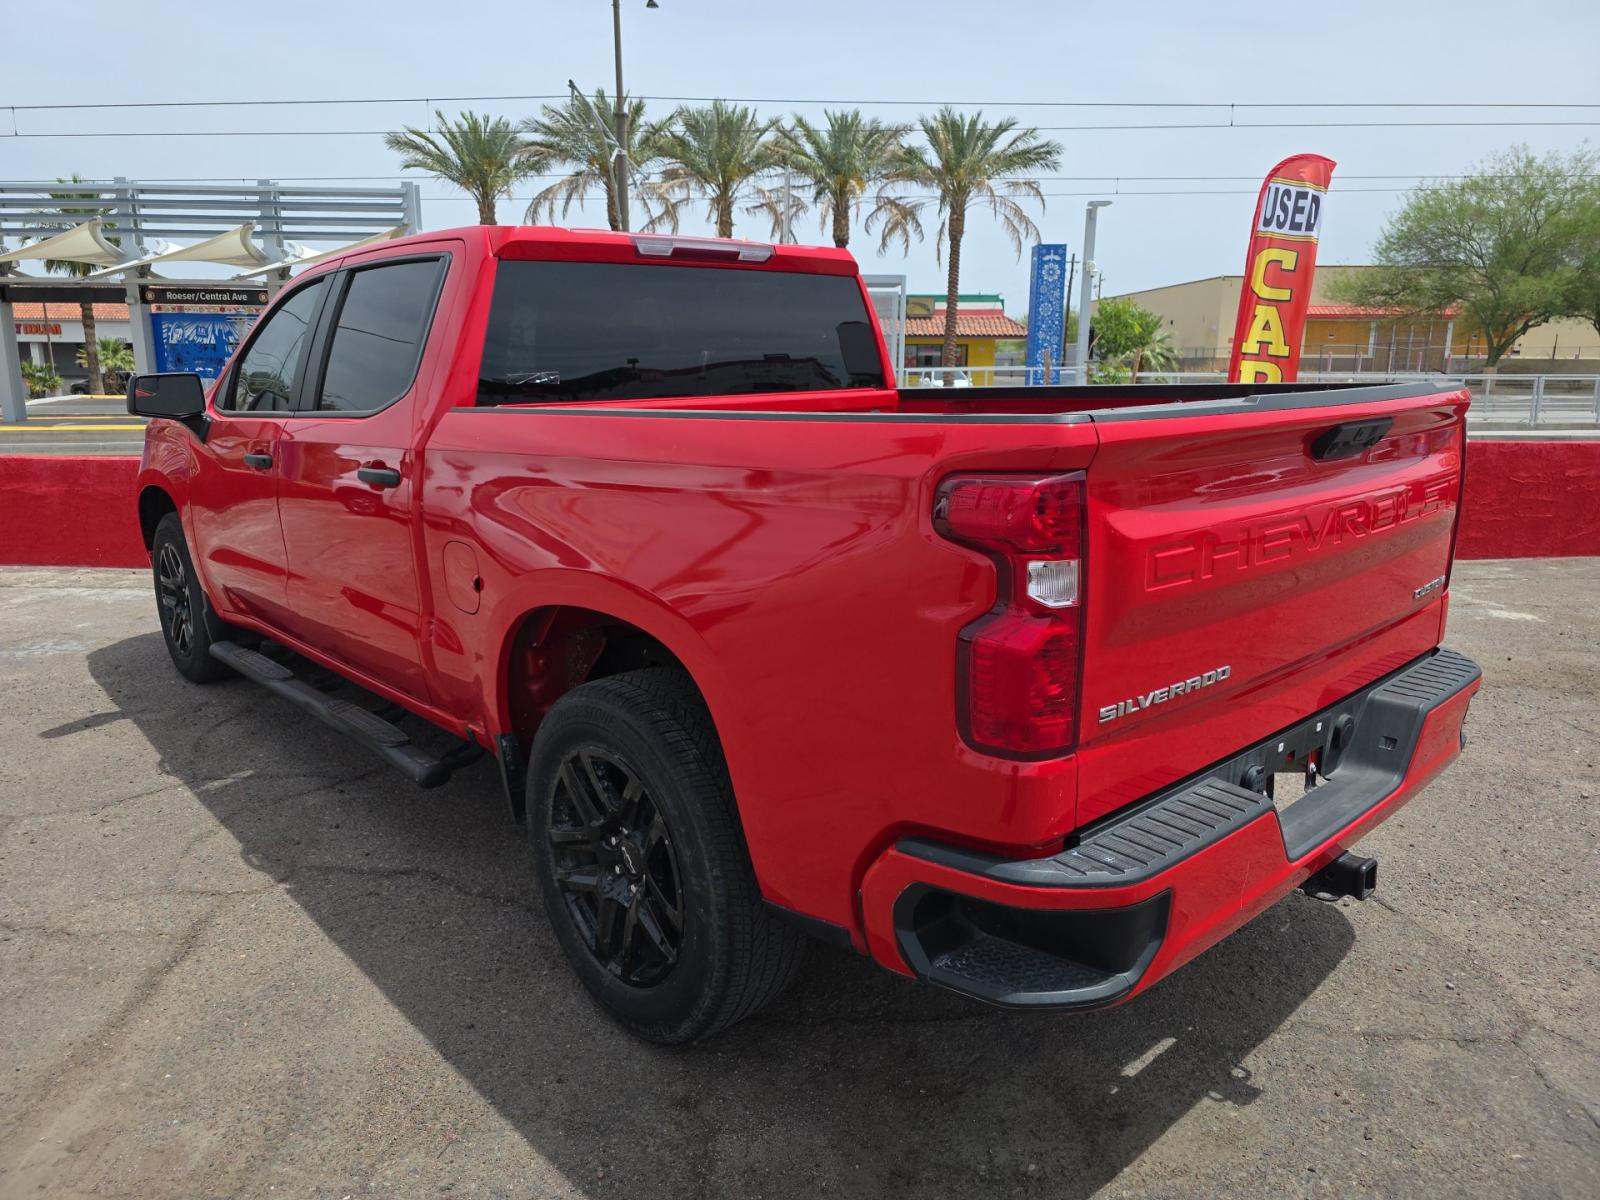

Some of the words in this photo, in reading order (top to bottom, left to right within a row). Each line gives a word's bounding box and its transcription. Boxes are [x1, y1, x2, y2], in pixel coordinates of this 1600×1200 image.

[1262, 185, 1321, 233] USED
[166, 291, 231, 301] Roeser/Central
[232, 292, 248, 301] Ave
[1098, 665, 1231, 724] SILVERADO
